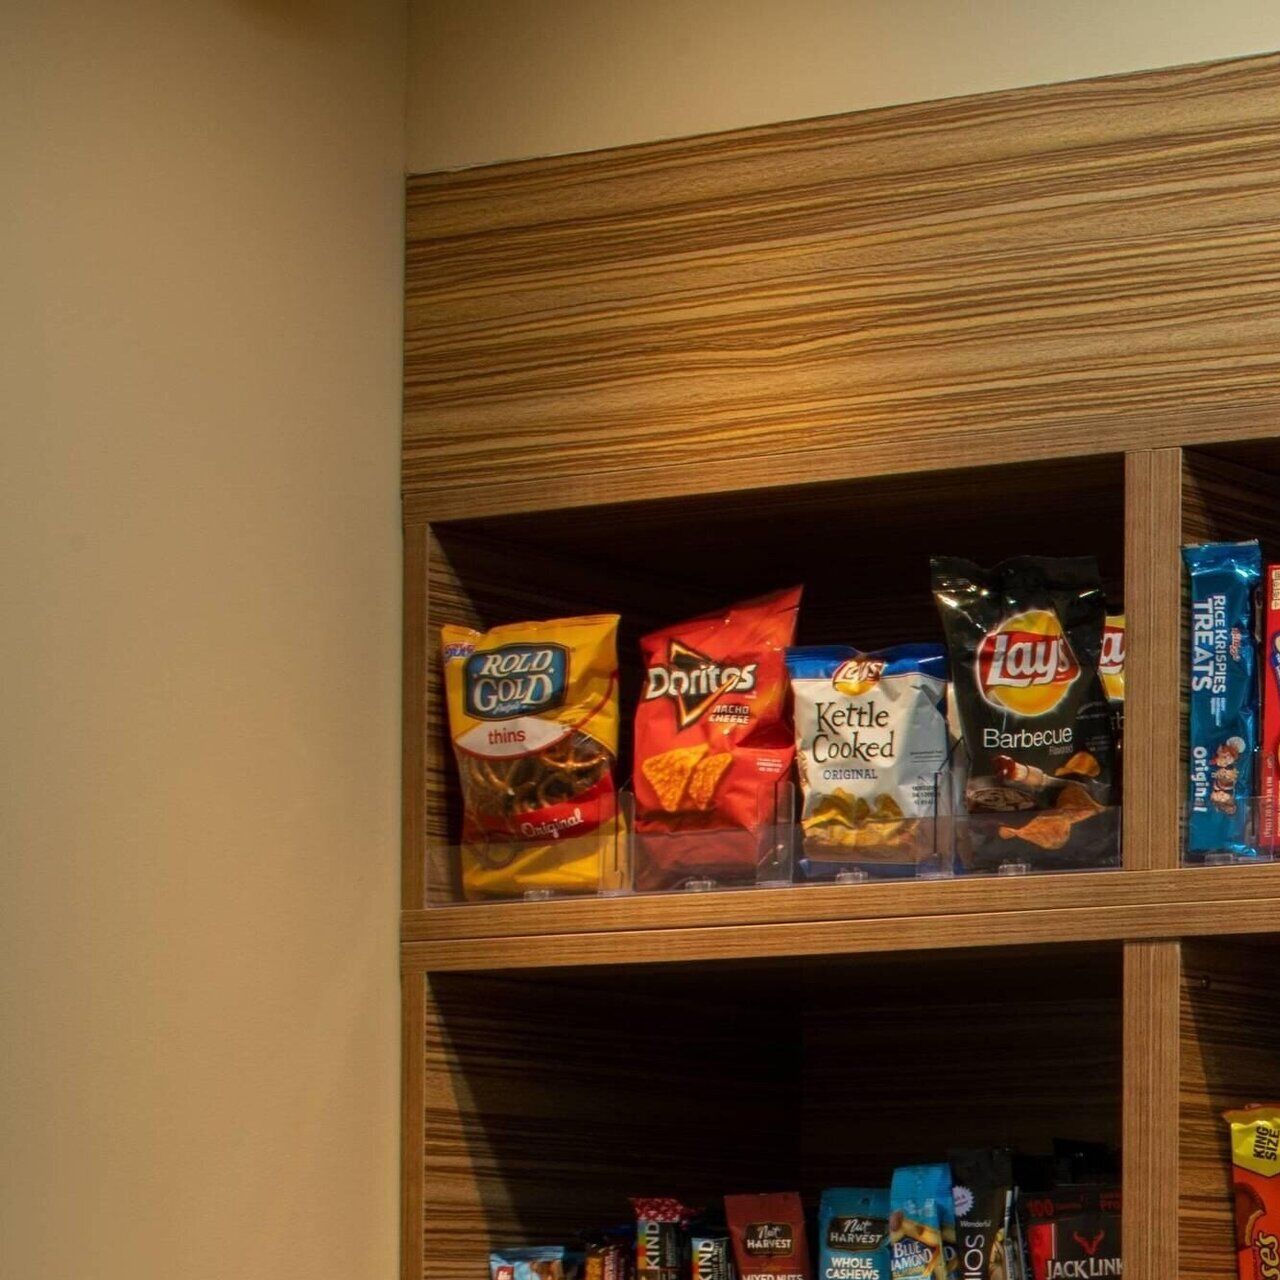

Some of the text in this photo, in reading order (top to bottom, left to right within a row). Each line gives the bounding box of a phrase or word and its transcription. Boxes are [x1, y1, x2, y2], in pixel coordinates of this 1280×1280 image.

[1213, 595, 1226, 626] RICE
[1192, 598, 1213, 692] TREATS
[482, 649, 554, 676] ROLD
[1213, 626, 1226, 694] KRISPIES
[474, 675, 553, 712] GOLD
[646, 664, 757, 699] Doritos
[709, 715, 750, 724] CHEESE
[714, 704, 749, 714] NACHO
[814, 702, 889, 736] Kettle
[488, 727, 526, 745] thins
[813, 731, 895, 763] Cooked
[983, 726, 1072, 749] Barbecue
[823, 769, 878, 780] ORIGINAL
[1192, 747, 1207, 812] original
[522, 810, 583, 838] Original
[1252, 1125, 1268, 1159] KING
[1265, 1129, 1280, 1162] SIZE
[647, 1221, 660, 1270] KIND
[747, 1238, 792, 1249] HARVEST
[830, 1231, 883, 1244] HARVEST
[893, 1241, 921, 1258] BLUE
[825, 1269, 880, 1280] CASHEWS
[831, 1257, 873, 1269] WHOLE
[1046, 1259, 1087, 1280] JACK
